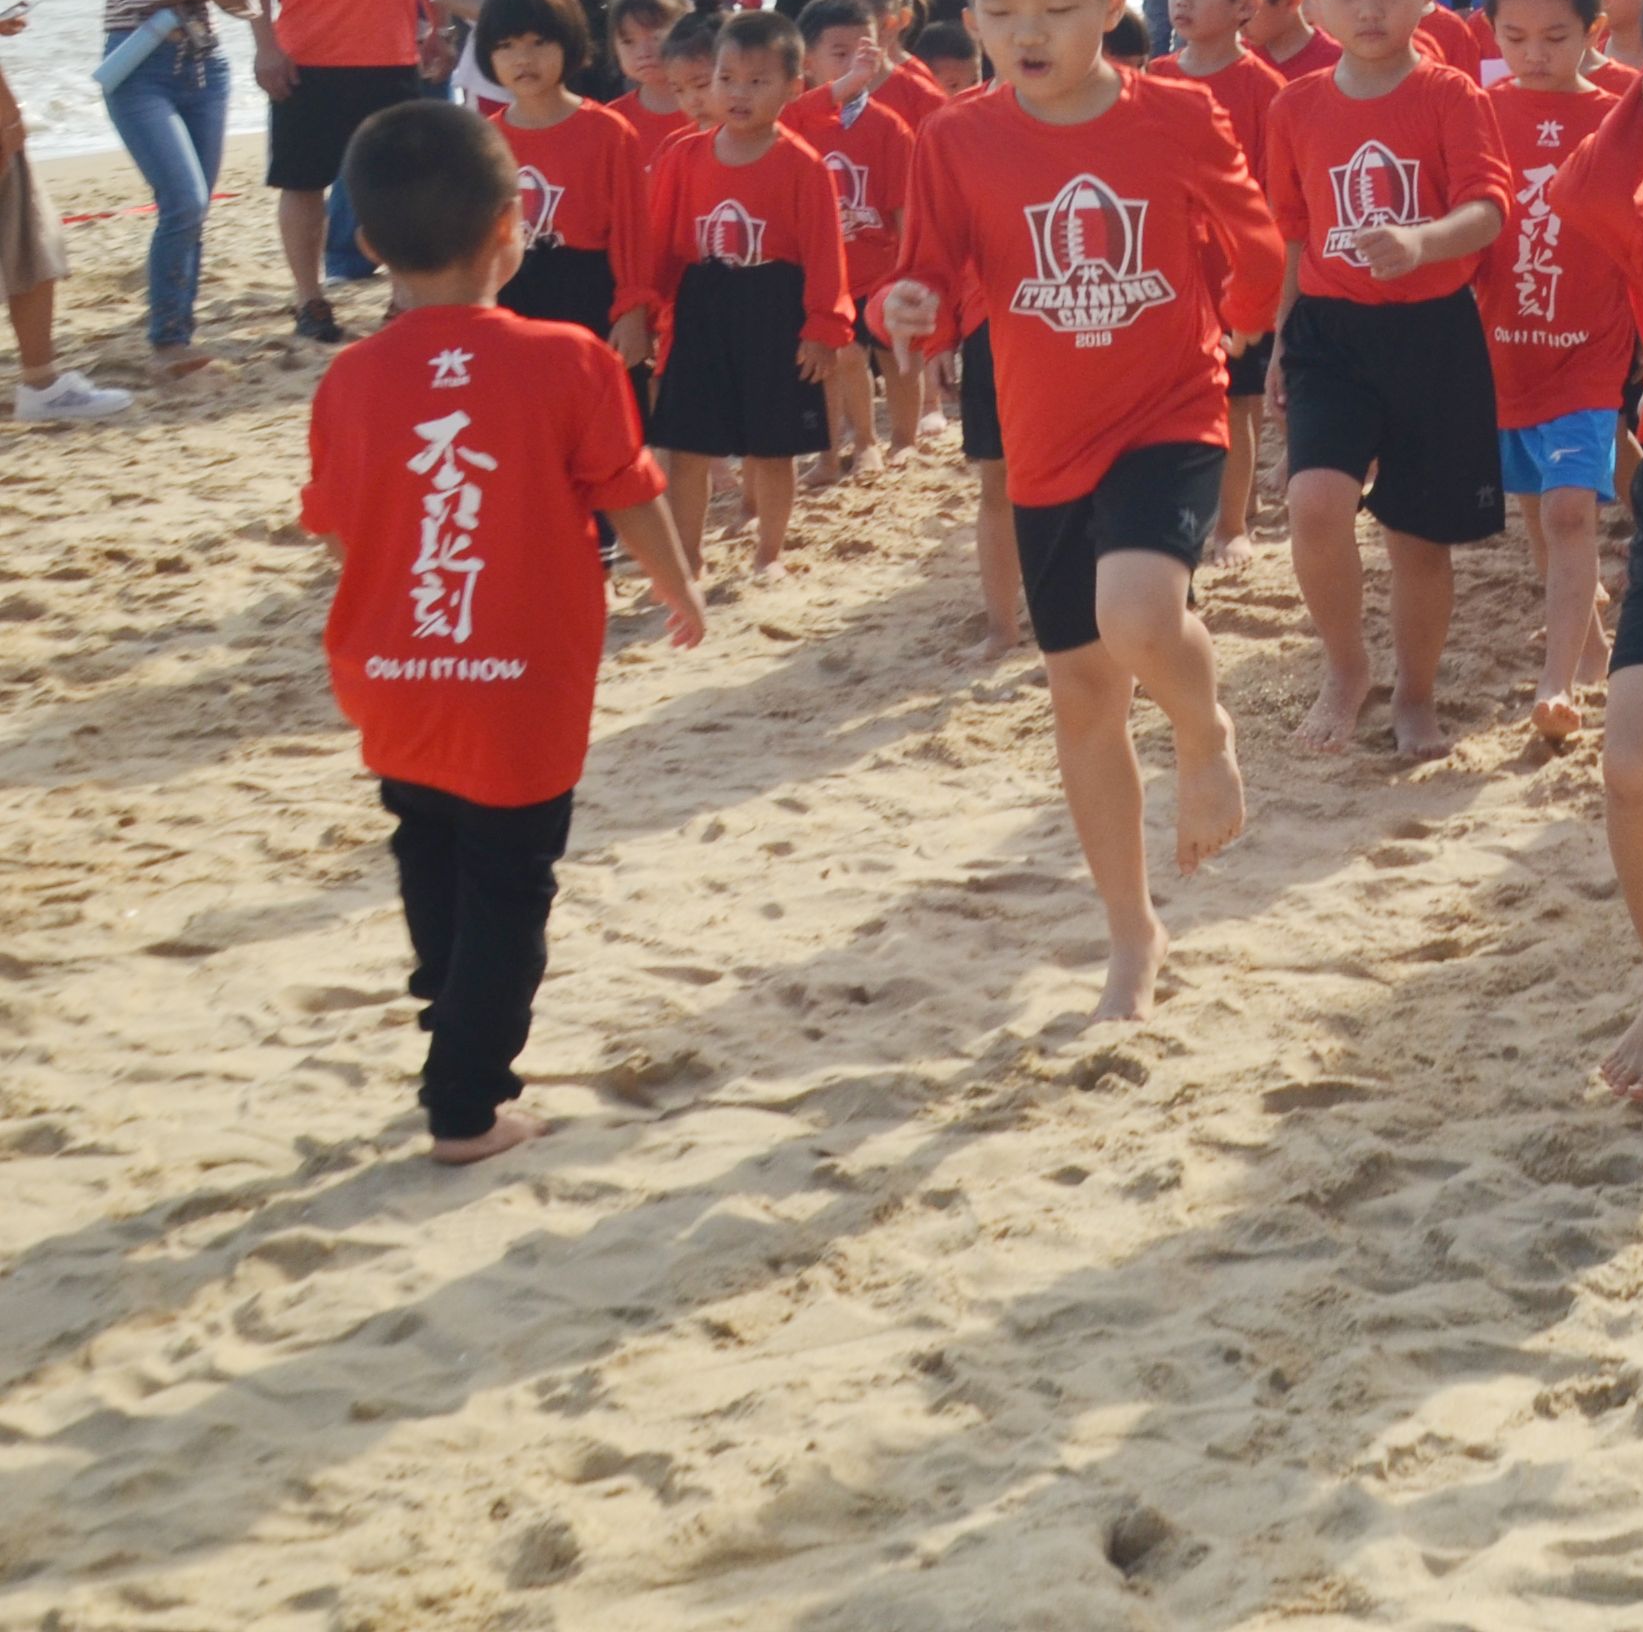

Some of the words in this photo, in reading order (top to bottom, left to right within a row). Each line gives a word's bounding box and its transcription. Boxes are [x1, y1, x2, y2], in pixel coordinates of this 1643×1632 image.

[1020, 277, 1166, 308] TRAINING
[1058, 305, 1127, 327] CAMP
[406, 409, 498, 643] 不负此刻
